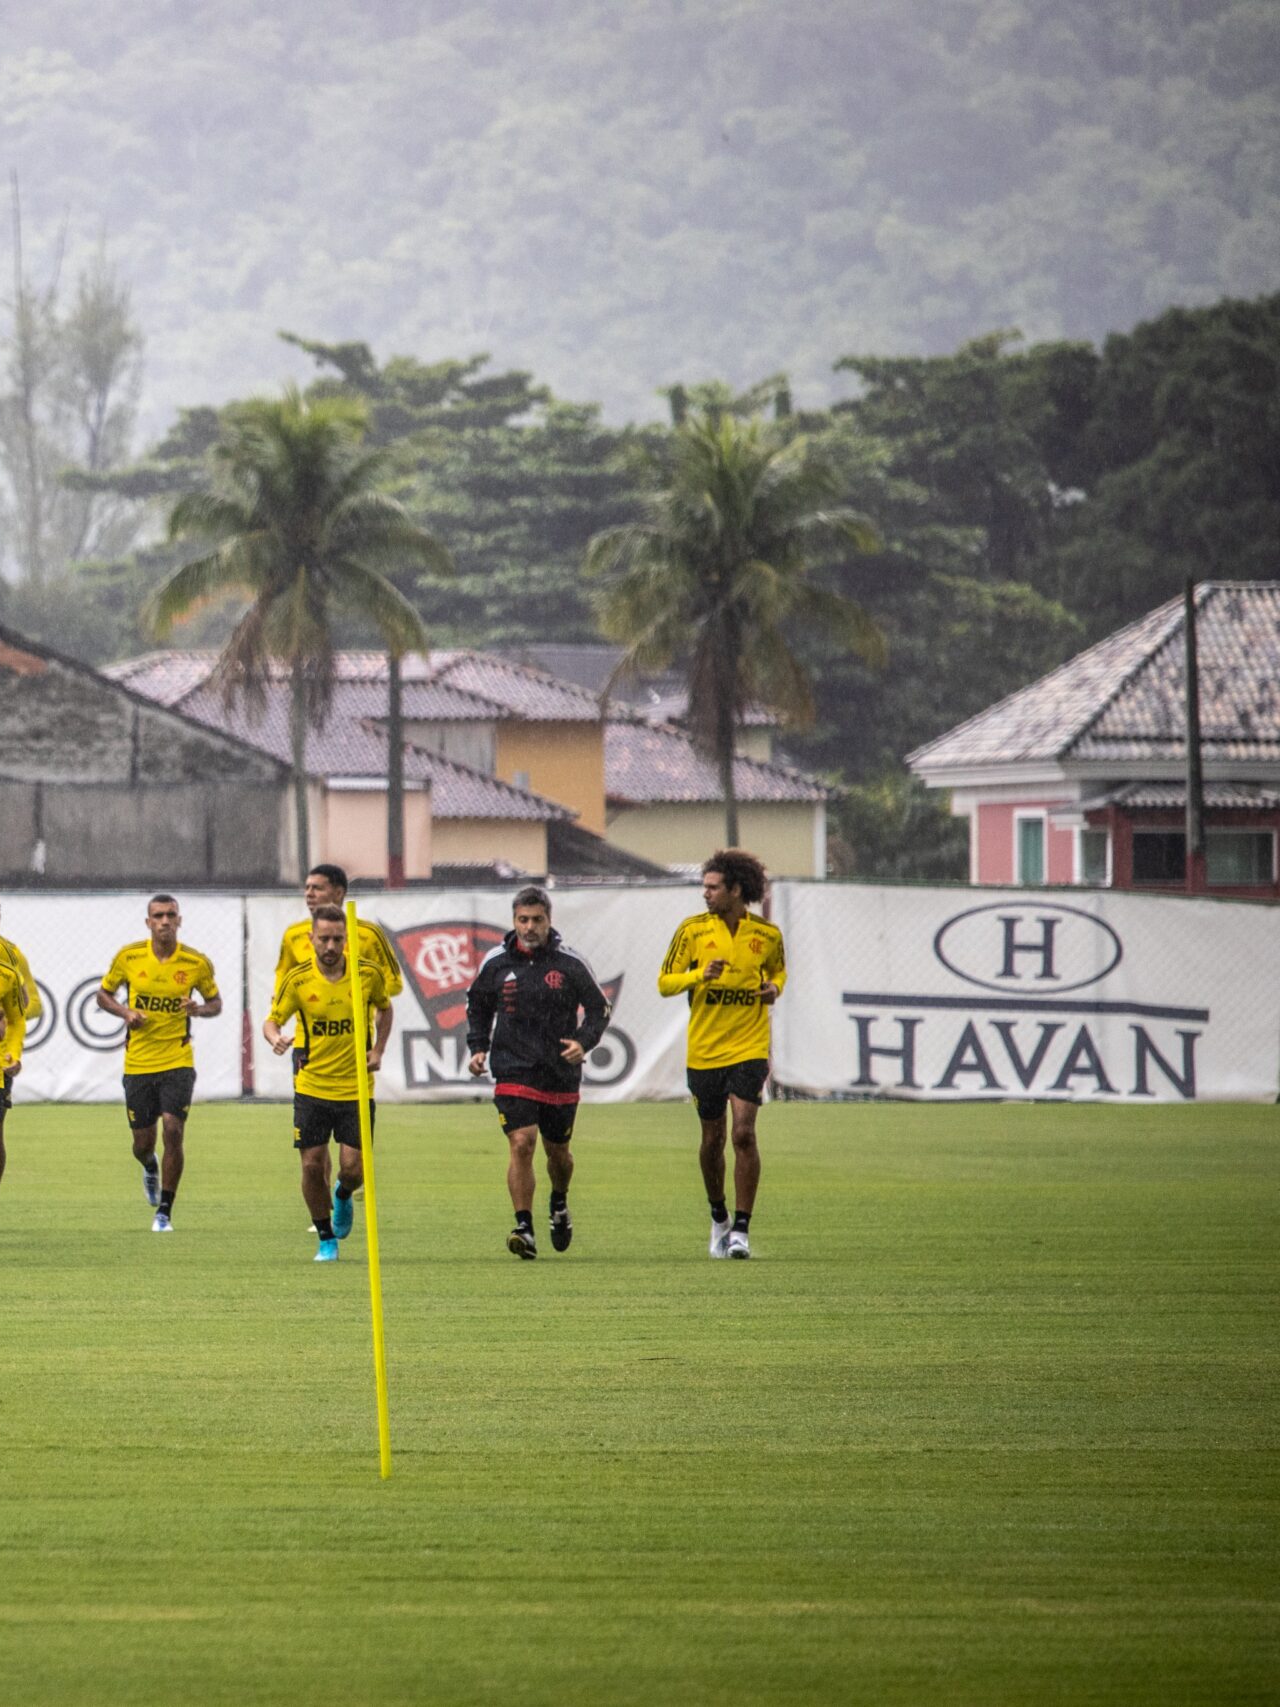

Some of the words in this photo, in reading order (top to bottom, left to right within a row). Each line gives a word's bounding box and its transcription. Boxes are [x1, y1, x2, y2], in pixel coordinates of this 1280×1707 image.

[996, 916, 1061, 980] H
[328, 1019, 354, 1036] BR
[849, 1016, 1202, 1099] HAVAN
